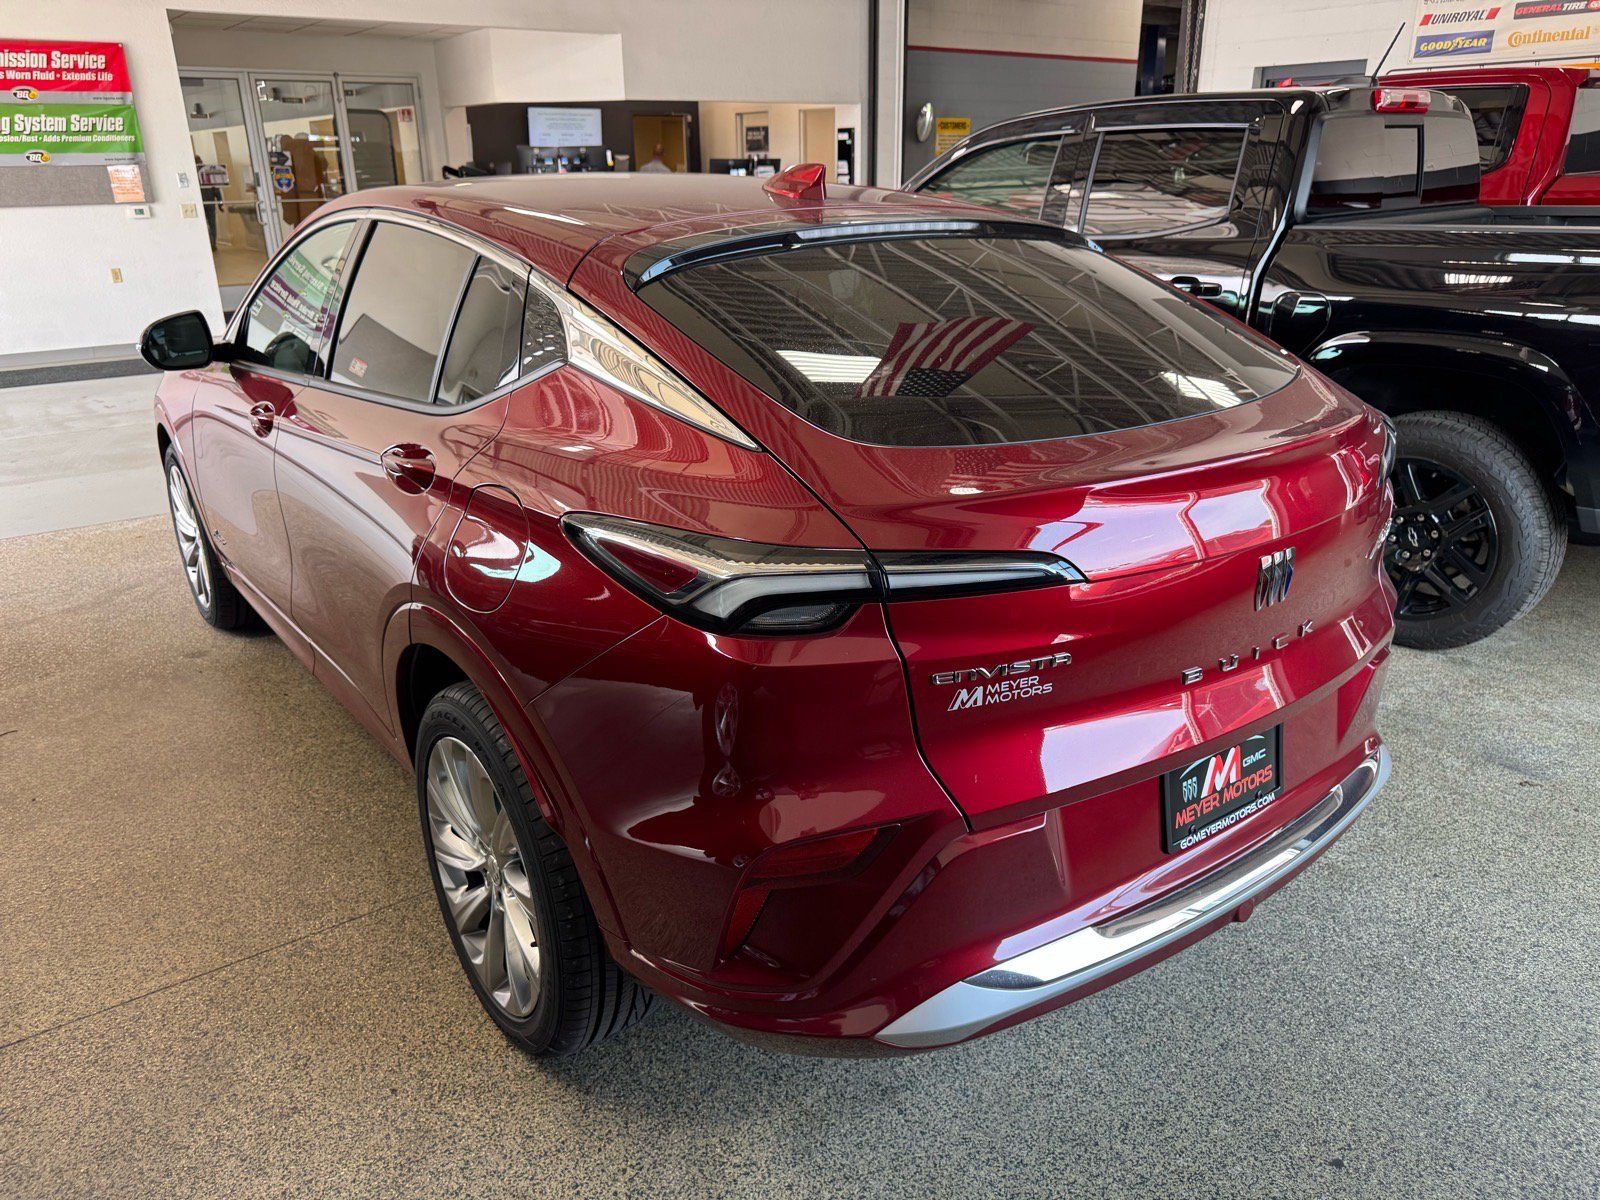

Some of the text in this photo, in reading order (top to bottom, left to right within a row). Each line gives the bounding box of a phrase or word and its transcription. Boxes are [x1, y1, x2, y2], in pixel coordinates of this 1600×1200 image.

[1431, 11, 1485, 25] UNIROYAL
[1515, 1, 1587, 16] GENERAL TIRE
[1420, 37, 1487, 51] GOODYEAR
[1508, 26, 1590, 48] Continental
[51, 50, 106, 69] Service
[6, 70, 31, 80] Worn
[32, 71, 55, 80] Fluid
[62, 72, 96, 81] Extends
[97, 73, 113, 81] Life
[14, 114, 67, 134] System
[70, 114, 124, 132] Service
[43, 135, 61, 143] Adds
[1182, 619, 1313, 685] BUICK
[931, 651, 1073, 686] ENVISTA
[985, 683, 1053, 706] MOTORS
[986, 675, 1039, 694] MEYER
[1242, 747, 1266, 768] GMC
[1175, 764, 1273, 829] MEYER MOTORS
[1180, 792, 1276, 850] GOMEYERMOTORS.COM
